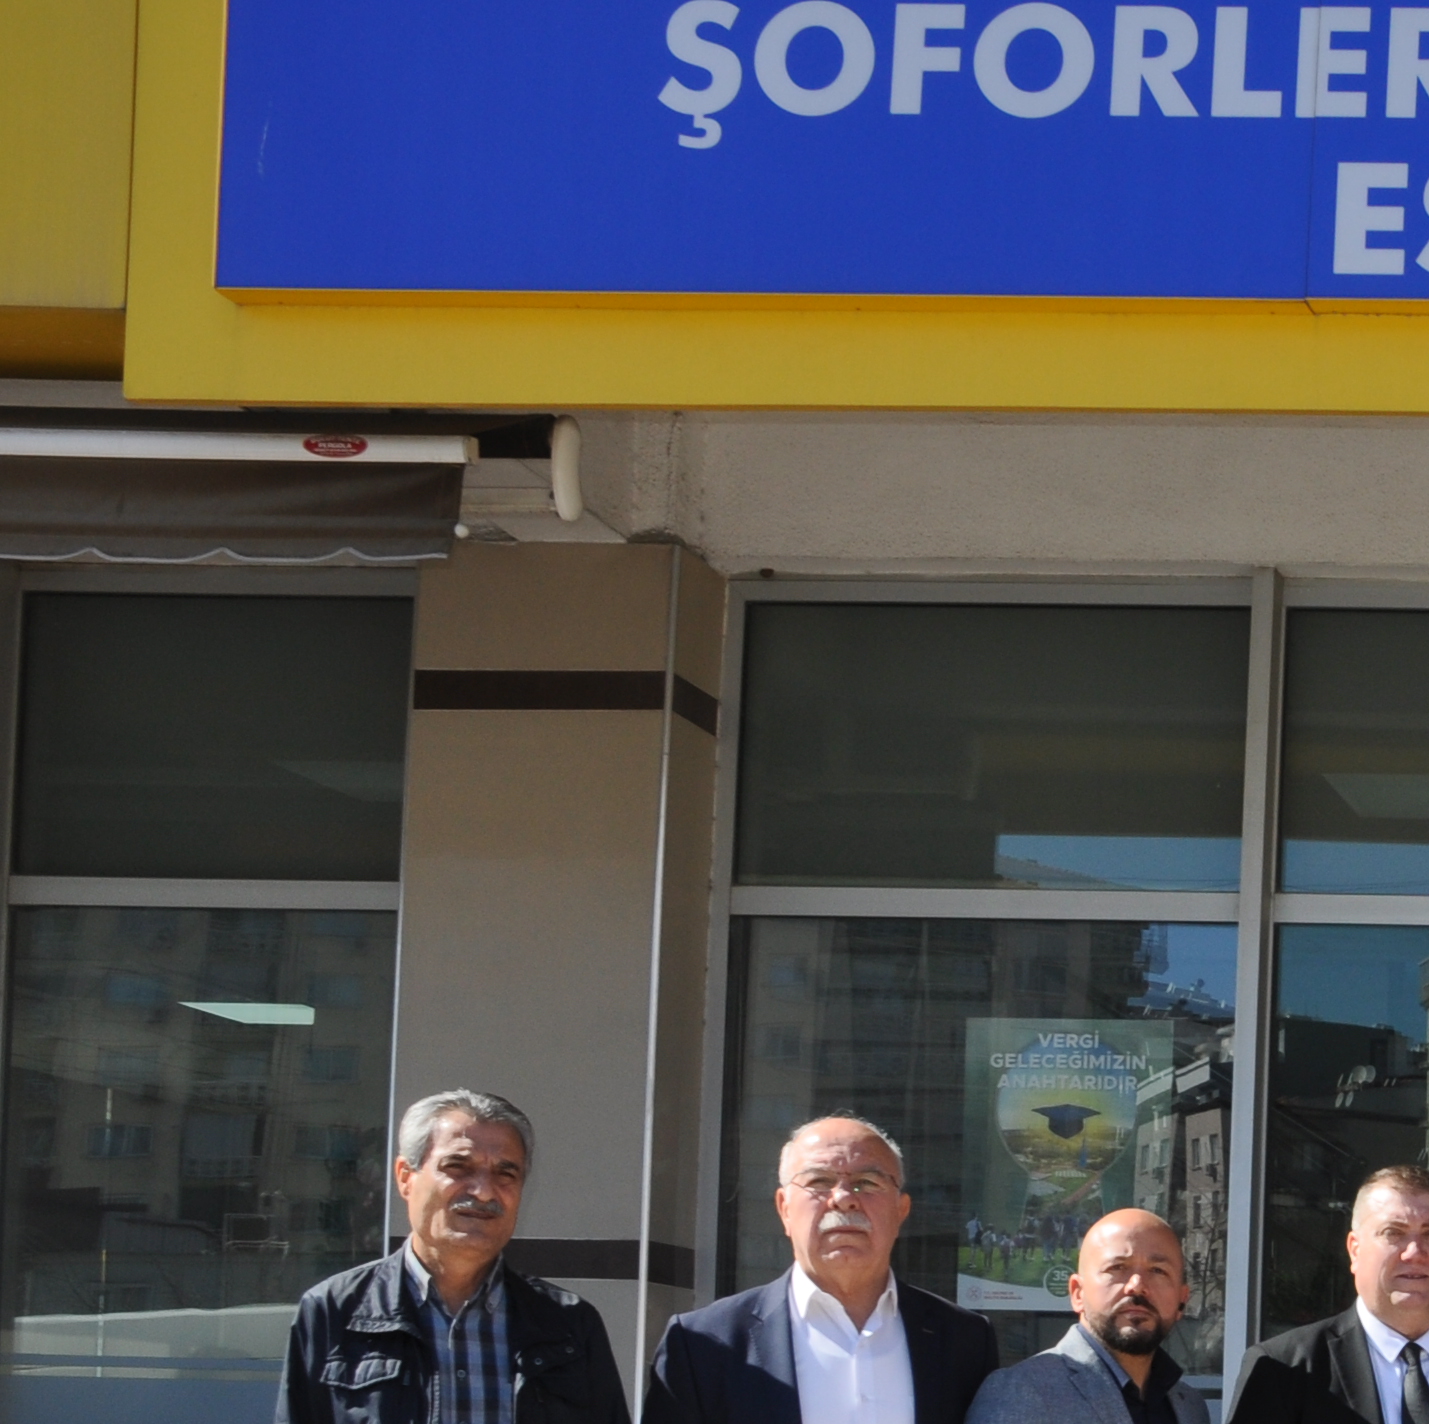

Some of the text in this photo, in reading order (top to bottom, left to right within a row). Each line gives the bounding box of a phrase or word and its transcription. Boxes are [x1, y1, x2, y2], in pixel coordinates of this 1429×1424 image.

[1038, 1030, 1100, 1049] VERGİ
[990, 1052, 1147, 1071] GELECEĞİMİZİN
[997, 1074, 1138, 1091] ANAHTARIDIR
